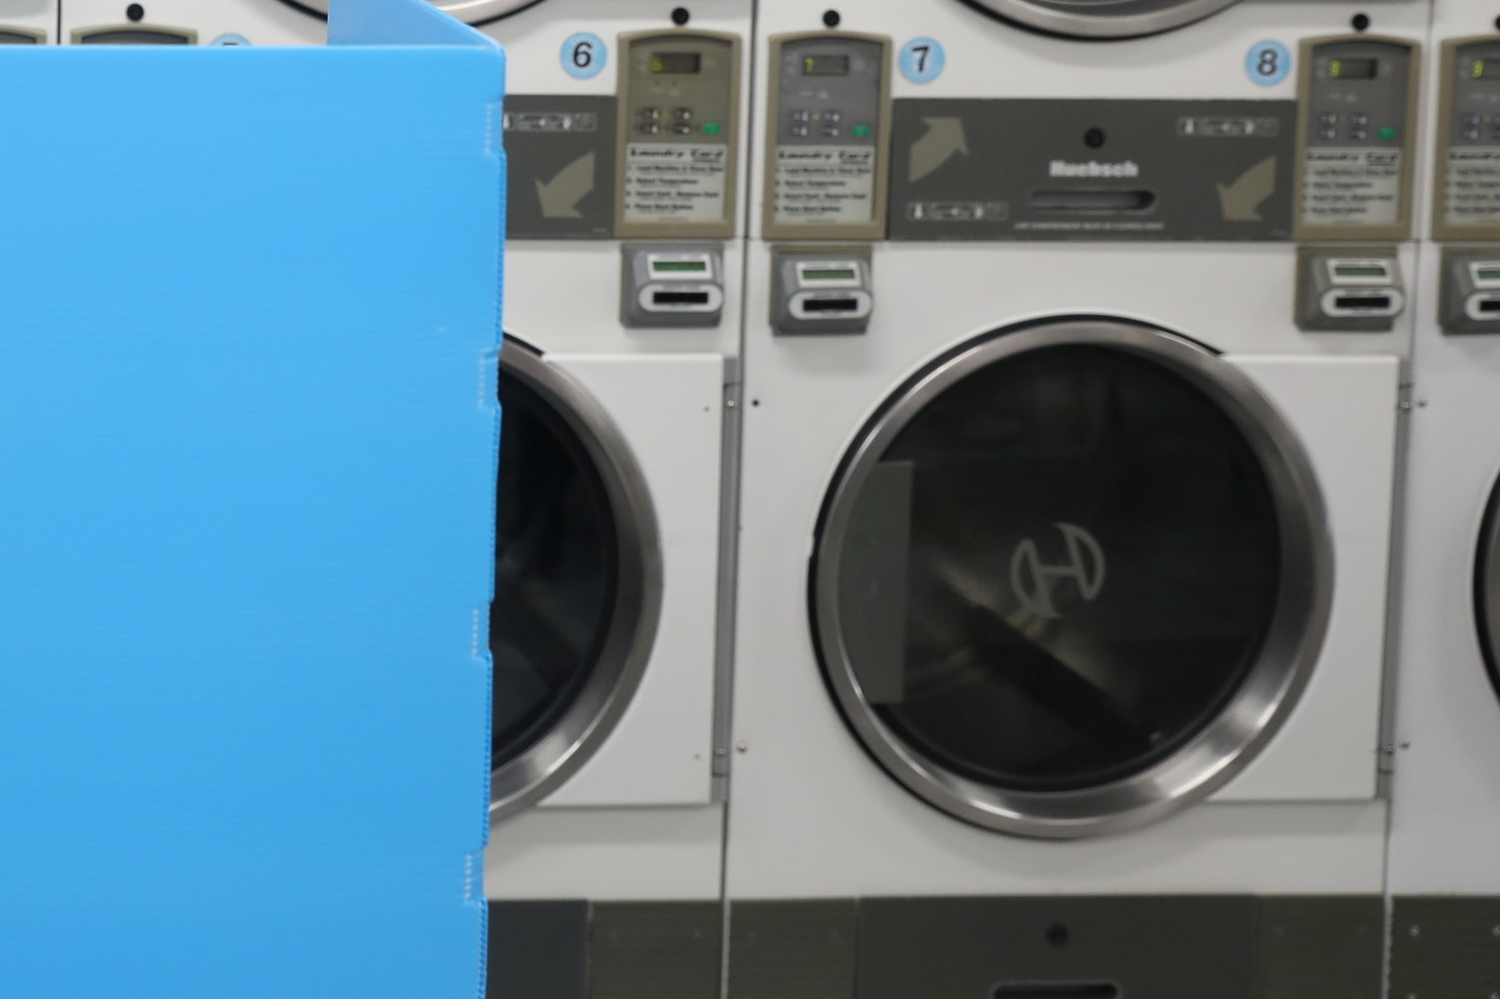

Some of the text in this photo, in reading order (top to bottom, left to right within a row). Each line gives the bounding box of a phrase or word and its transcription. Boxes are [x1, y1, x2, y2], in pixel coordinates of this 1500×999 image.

[572, 41, 593, 68] 6
[911, 45, 930, 73] 7
[1257, 48, 1278, 76] 8
